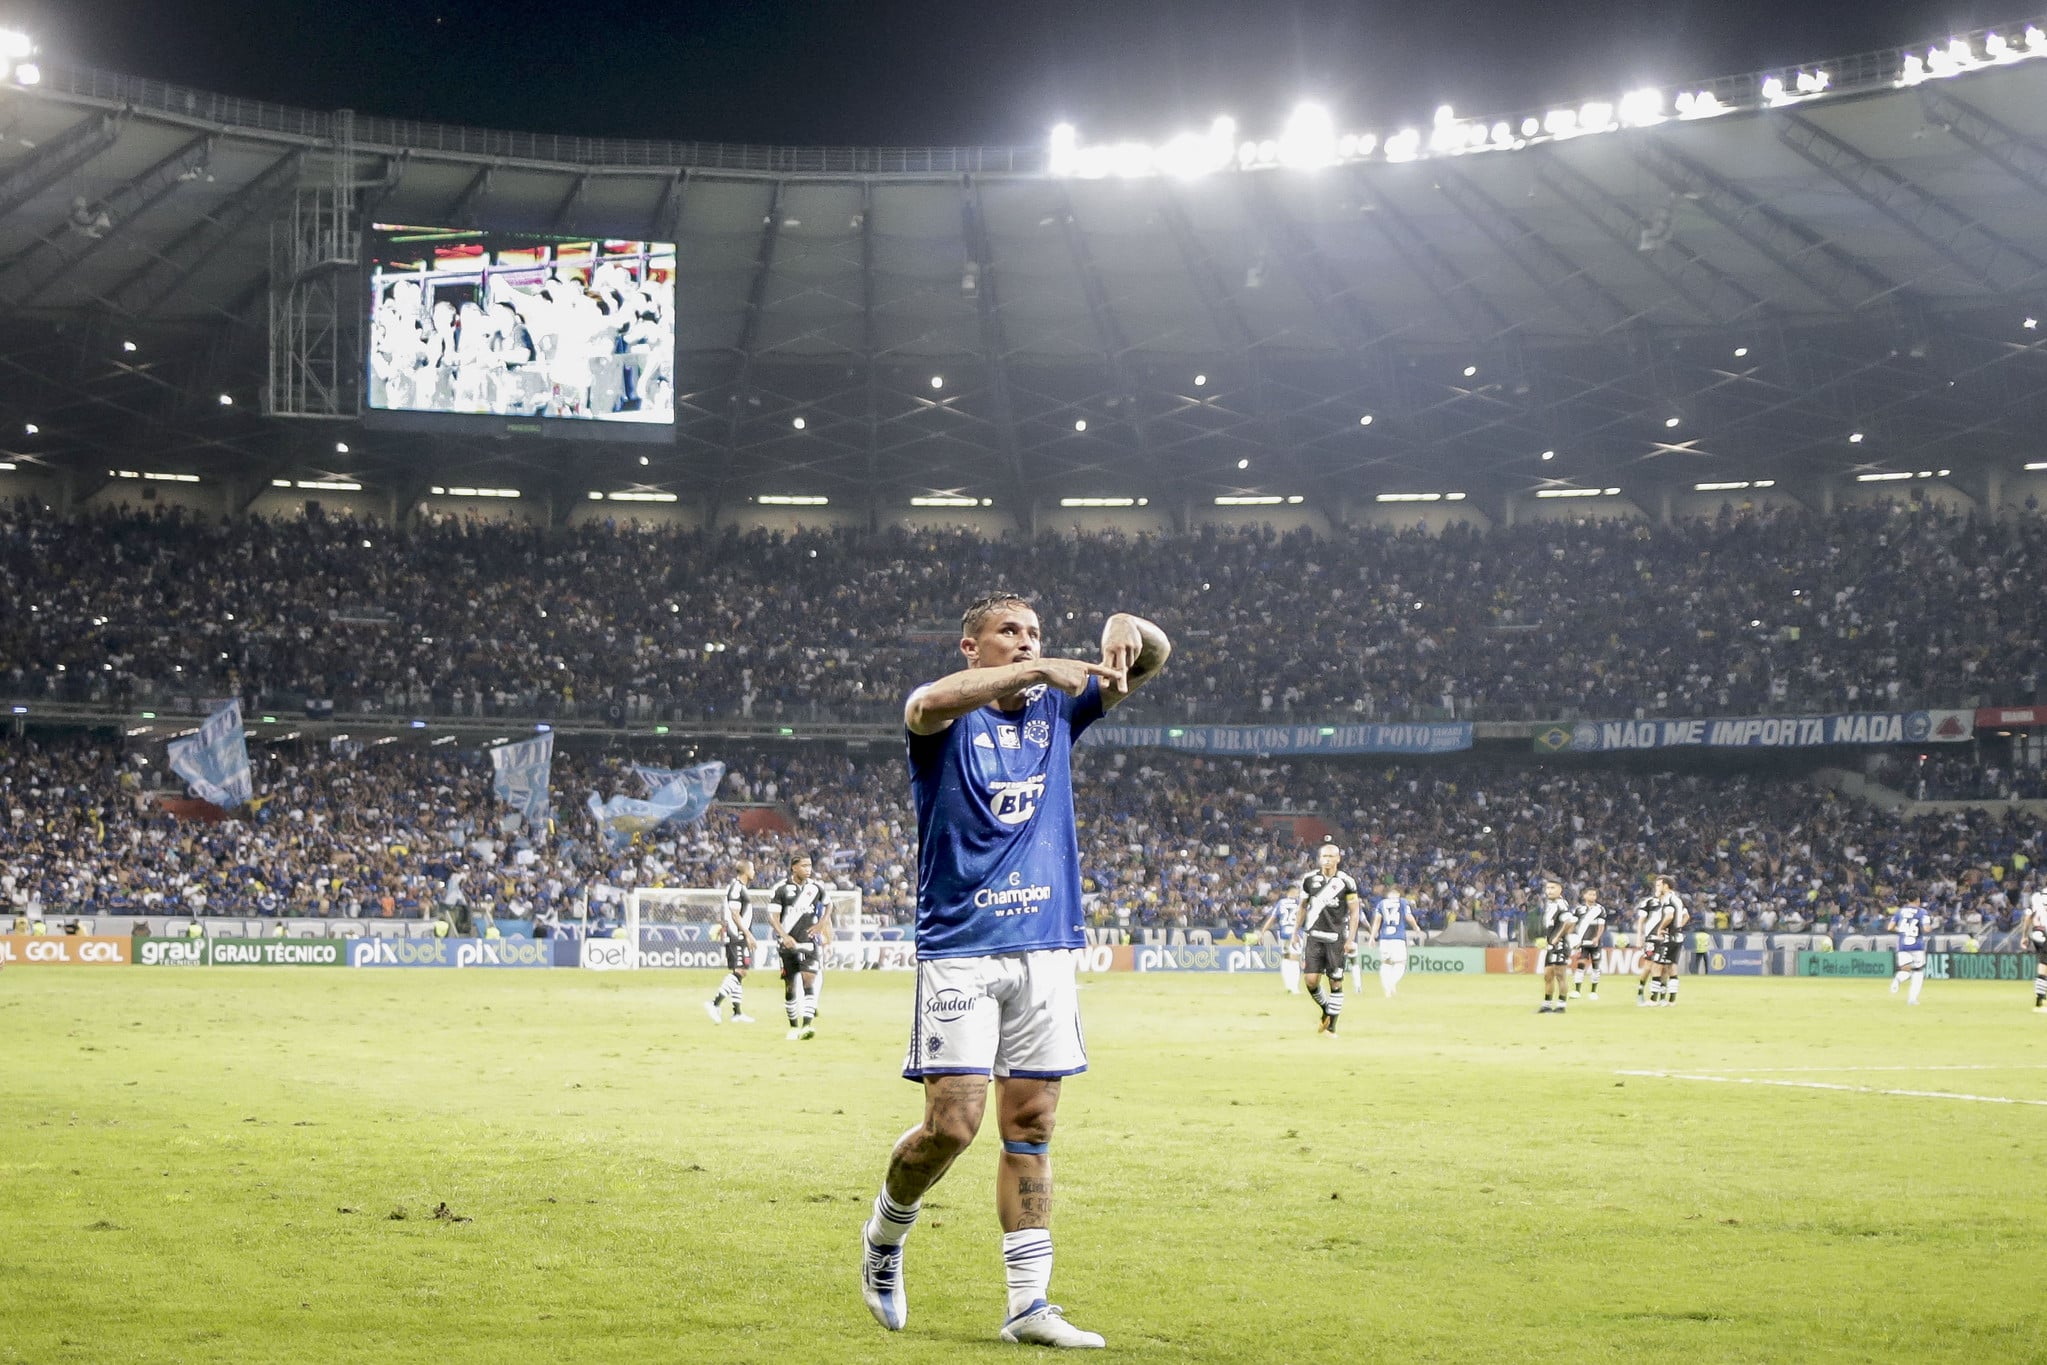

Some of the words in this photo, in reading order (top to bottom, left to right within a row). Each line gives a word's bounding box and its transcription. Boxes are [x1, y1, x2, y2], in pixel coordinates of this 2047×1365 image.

[1376, 725, 1430, 746] POVO
[1602, 720, 1656, 750] NÃO
[1663, 720, 1704, 745] ME
[1710, 717, 1823, 746] IMPORTA
[1833, 714, 1901, 744] NADA
[998, 788, 1039, 816] BH
[974, 884, 1052, 908] Champion
[995, 906, 1039, 917] WATCH
[25, 941, 71, 963] GOL
[78, 941, 124, 963] GOL
[141, 939, 205, 965] grau
[214, 944, 261, 964] GRAU
[265, 941, 337, 964] TÉCNICO
[354, 937, 448, 968] pixbet
[456, 937, 549, 968] pixbet
[1140, 944, 1221, 972] pixbet
[1229, 944, 1281, 972] pixb
[1408, 954, 1465, 972] Pitaco
[1954, 953, 1996, 979] TODOS
[2000, 954, 2018, 979] OS
[924, 996, 976, 1014] Saudali
